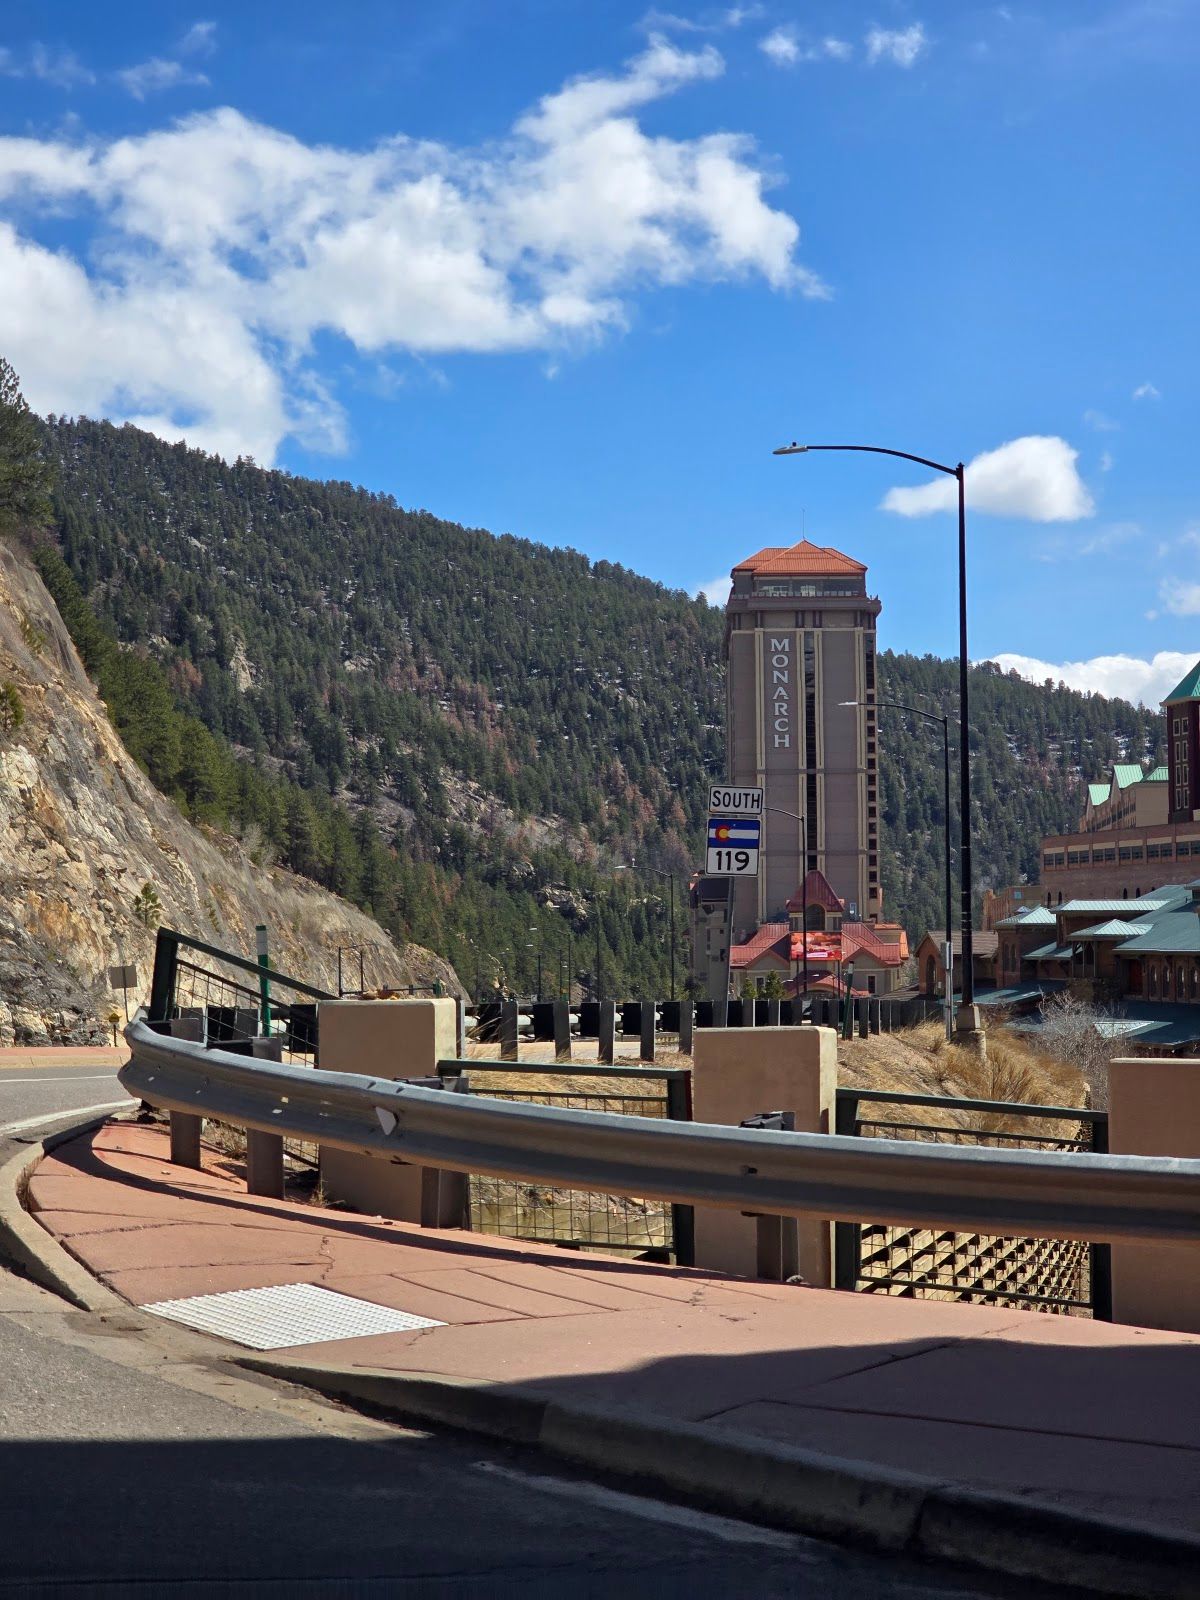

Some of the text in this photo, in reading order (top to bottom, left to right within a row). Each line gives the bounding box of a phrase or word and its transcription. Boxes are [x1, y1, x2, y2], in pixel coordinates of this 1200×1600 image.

[770, 638, 790, 748] MONARCH
[712, 790, 760, 809] SOUTH
[716, 850, 750, 871] 119
